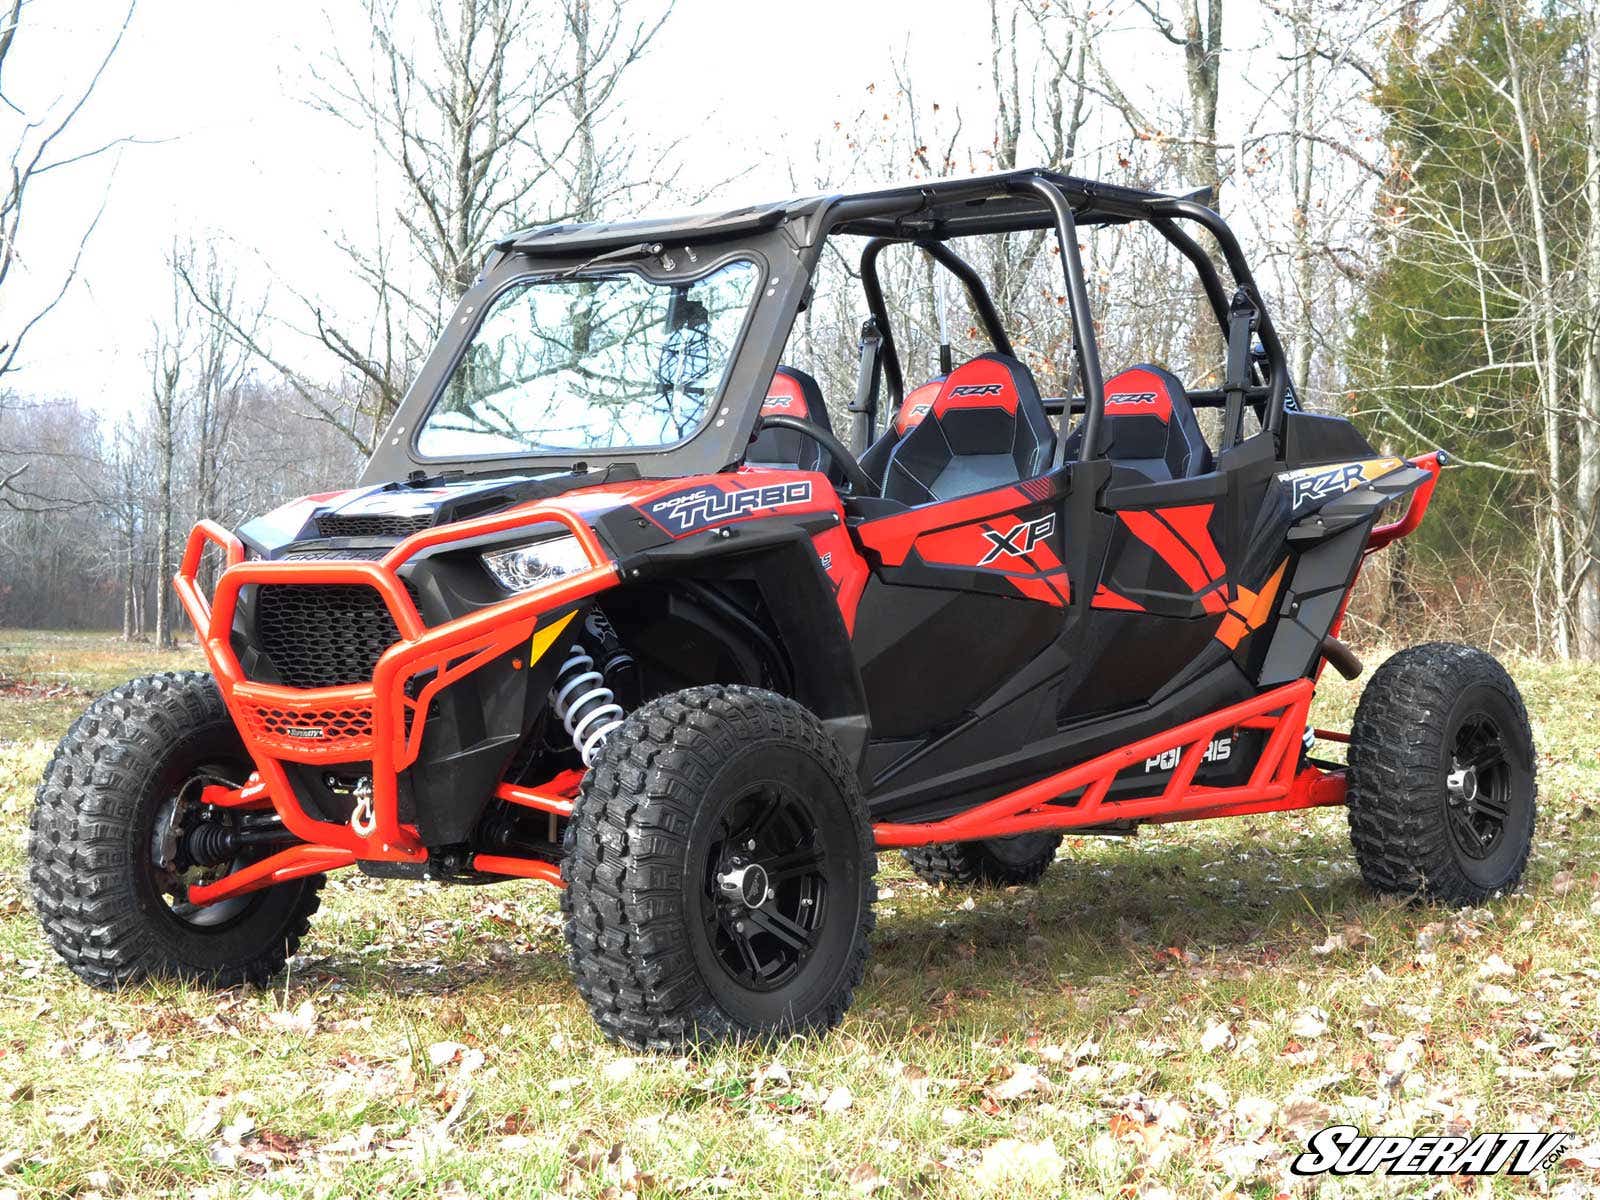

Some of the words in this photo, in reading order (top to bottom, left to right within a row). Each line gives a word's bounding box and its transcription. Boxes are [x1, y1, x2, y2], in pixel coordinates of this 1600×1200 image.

[948, 384, 1004, 399] RZR
[1105, 393, 1159, 407] RZR
[652, 490, 707, 512] DOHC
[669, 480, 812, 529] TURBO
[1292, 463, 1371, 511] RZR
[976, 512, 1056, 567] XP
